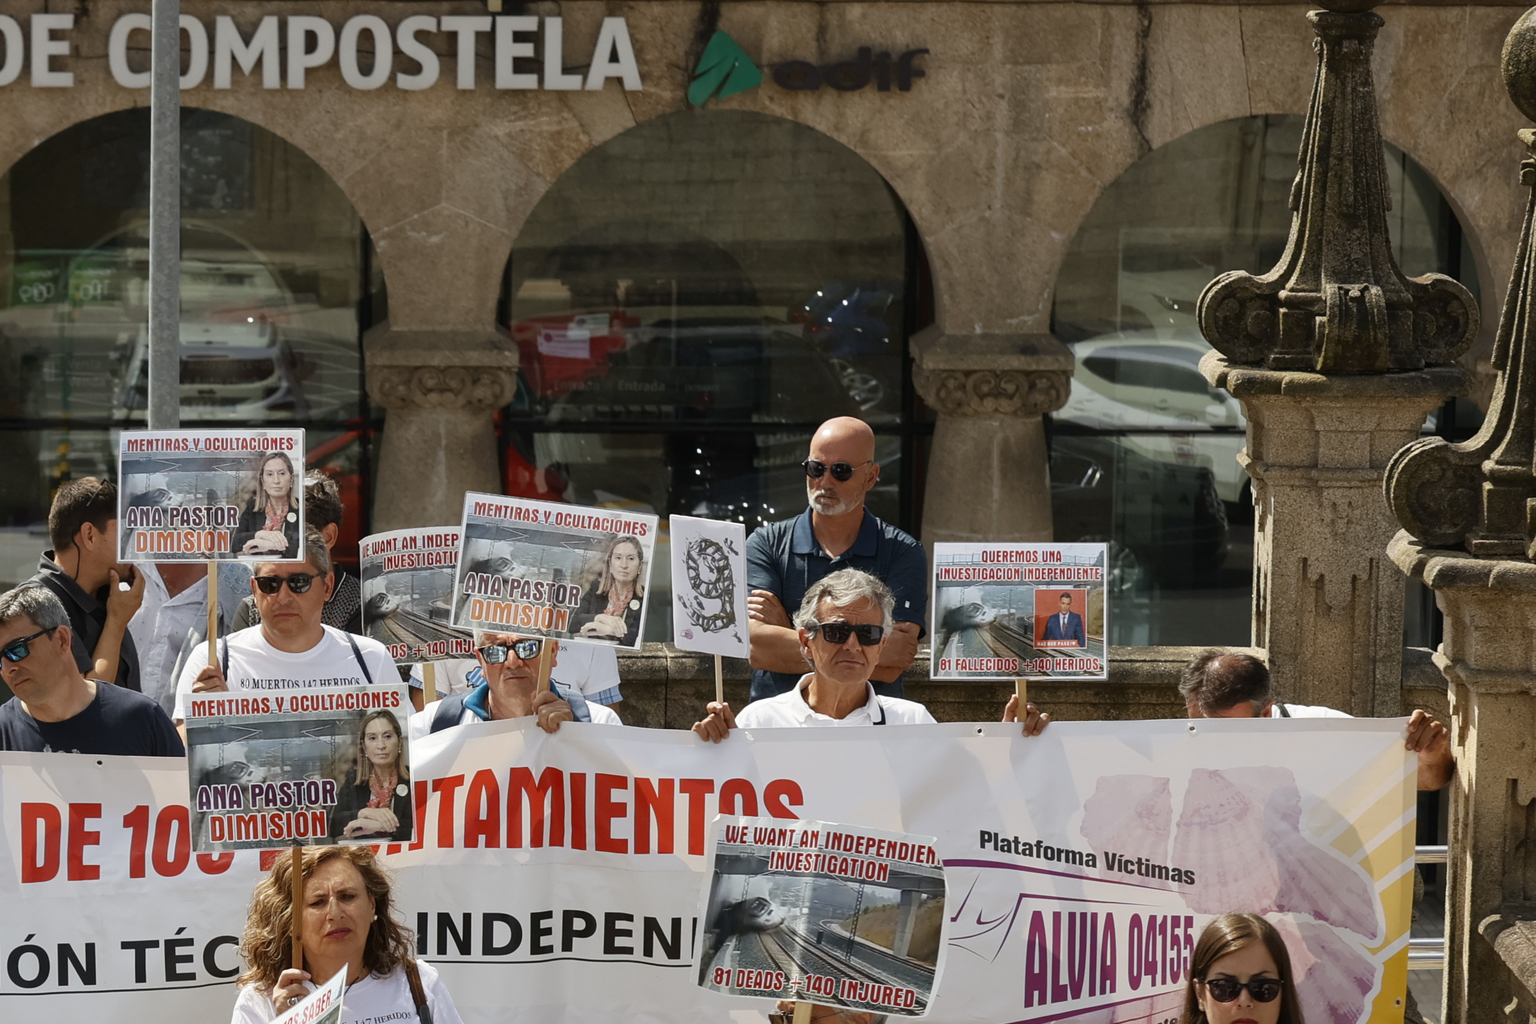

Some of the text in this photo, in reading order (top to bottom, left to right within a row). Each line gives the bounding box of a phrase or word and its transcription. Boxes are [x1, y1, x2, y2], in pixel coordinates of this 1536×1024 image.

[108, 14, 643, 92] COMPOSTELA
[773, 46, 929, 94] adif
[127, 437, 294, 451] MENTIRAS Y OCULTACIONES
[127, 507, 238, 527] ANA PASTOR
[473, 502, 648, 536] MENTIRAS Y OCULTACIONES
[136, 527, 230, 552] DIMISIÓN
[939, 565, 1101, 581] INVESTIGACIÓN INDEPENDIENTE
[982, 551, 1062, 564] QUEREMOS UNA
[464, 573, 581, 606] ANA PASTOR
[471, 599, 568, 631] DIMISIÓN
[940, 658, 1099, 671] 81 FALLECIDOS HERIDOS
[252, 678, 300, 690] MUERTOS
[192, 691, 400, 717] MENTIRAS Y OCULTACIONES
[197, 780, 337, 812] ANA PASTOR
[210, 806, 327, 843] DIMISIÓN
[725, 825, 819, 848] WE WANT AN
[21, 801, 102, 884] DE
[980, 830, 1195, 885] Plataforma Víctimas
[769, 851, 889, 881] INVESTIGATION
[1024, 910, 1194, 1009] ALVIA 04155
[714, 968, 915, 1008] 81 DEADS INJURED
[302, 989, 332, 1024] SABER
[374, 1011, 412, 1024] HERIDOS
